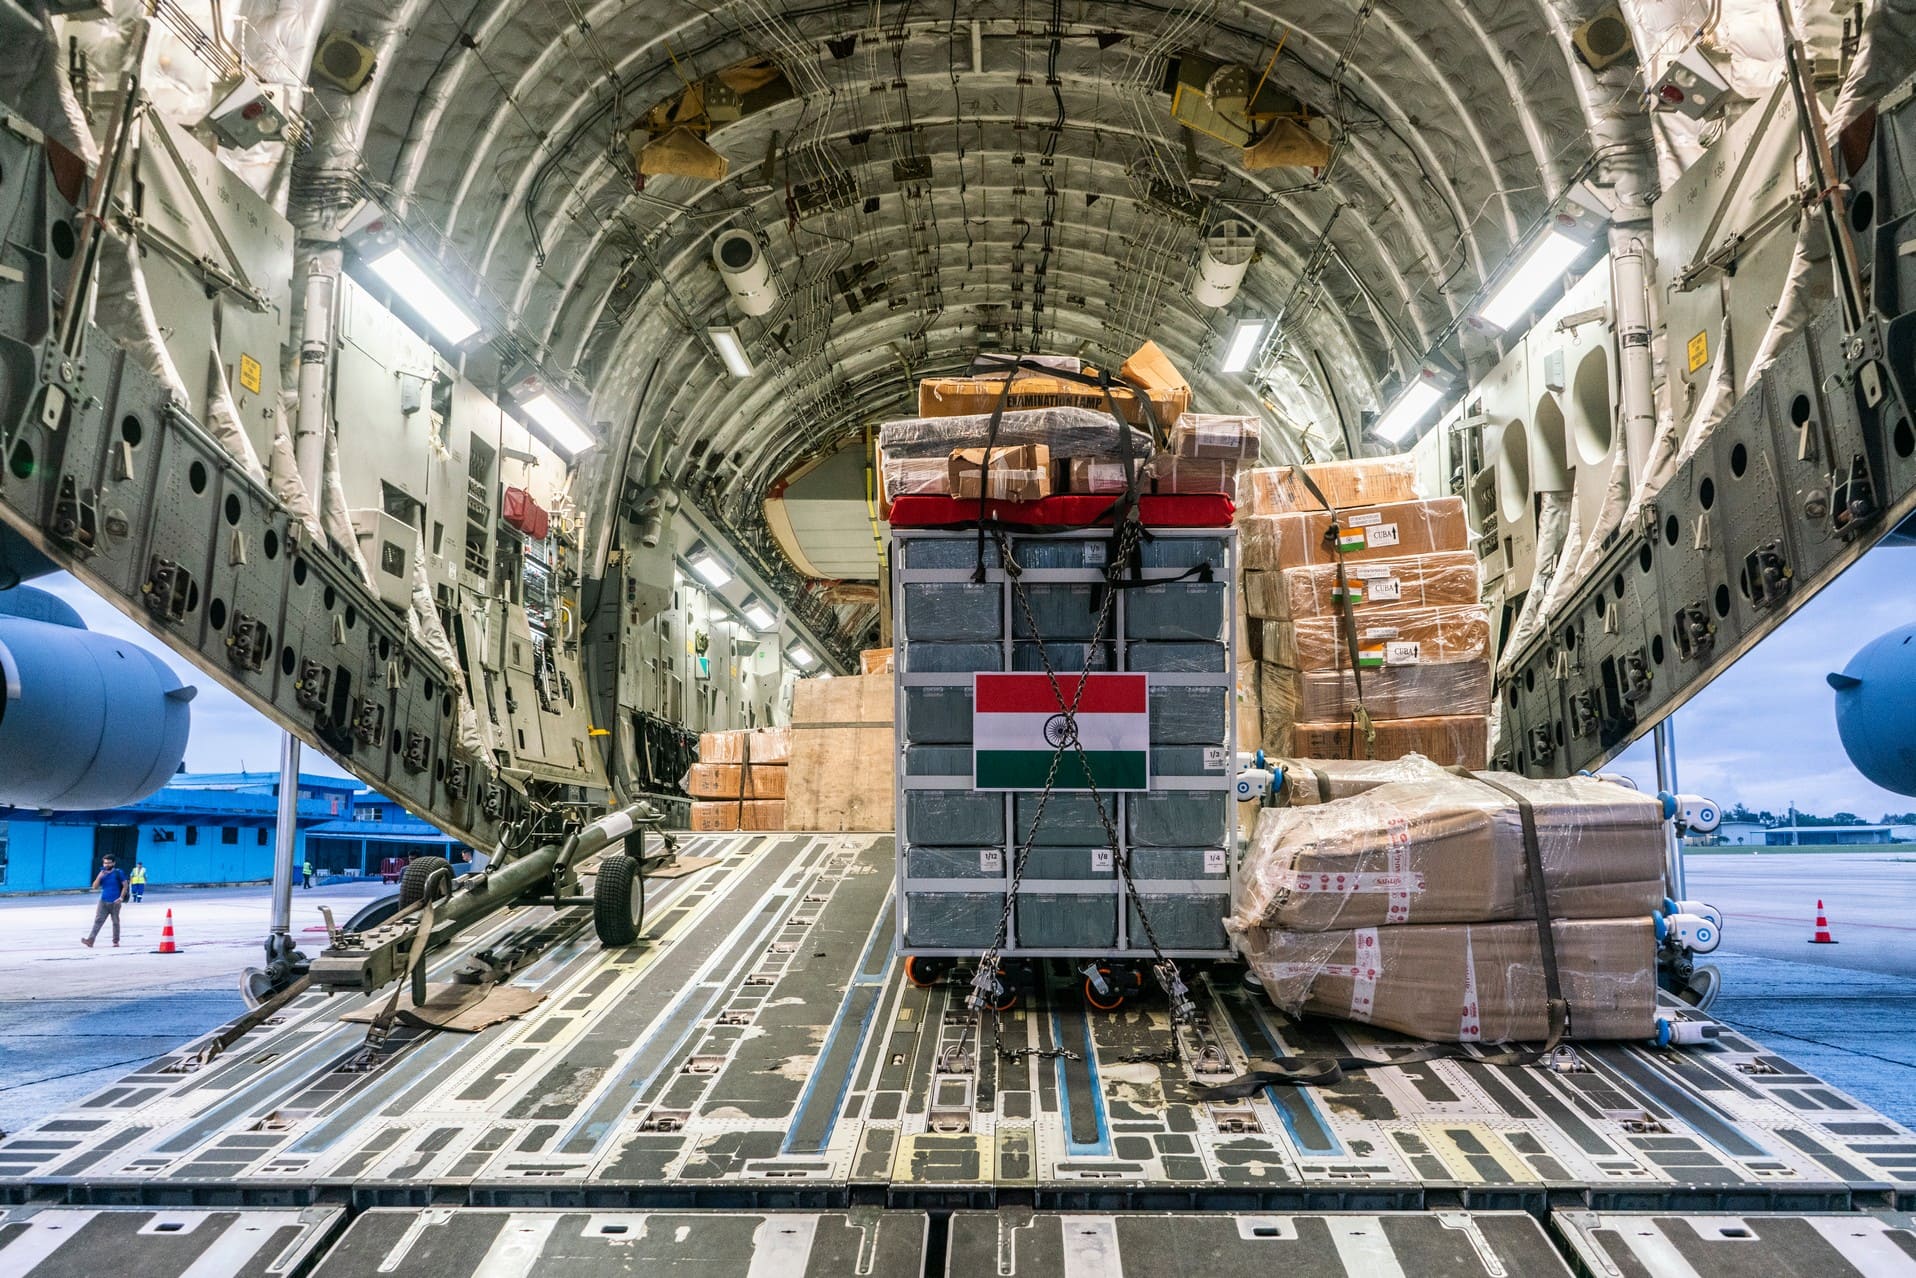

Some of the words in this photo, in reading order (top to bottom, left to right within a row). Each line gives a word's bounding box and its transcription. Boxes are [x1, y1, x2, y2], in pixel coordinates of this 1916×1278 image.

[1007, 394, 1072, 408] EXAMINATION
[1074, 395, 1102, 409] LAMP
[1373, 530, 1392, 539] CUBA
[1375, 584, 1394, 592] CUBA
[1394, 647, 1414, 656] CUBA
[985, 852, 997, 861] 1/12
